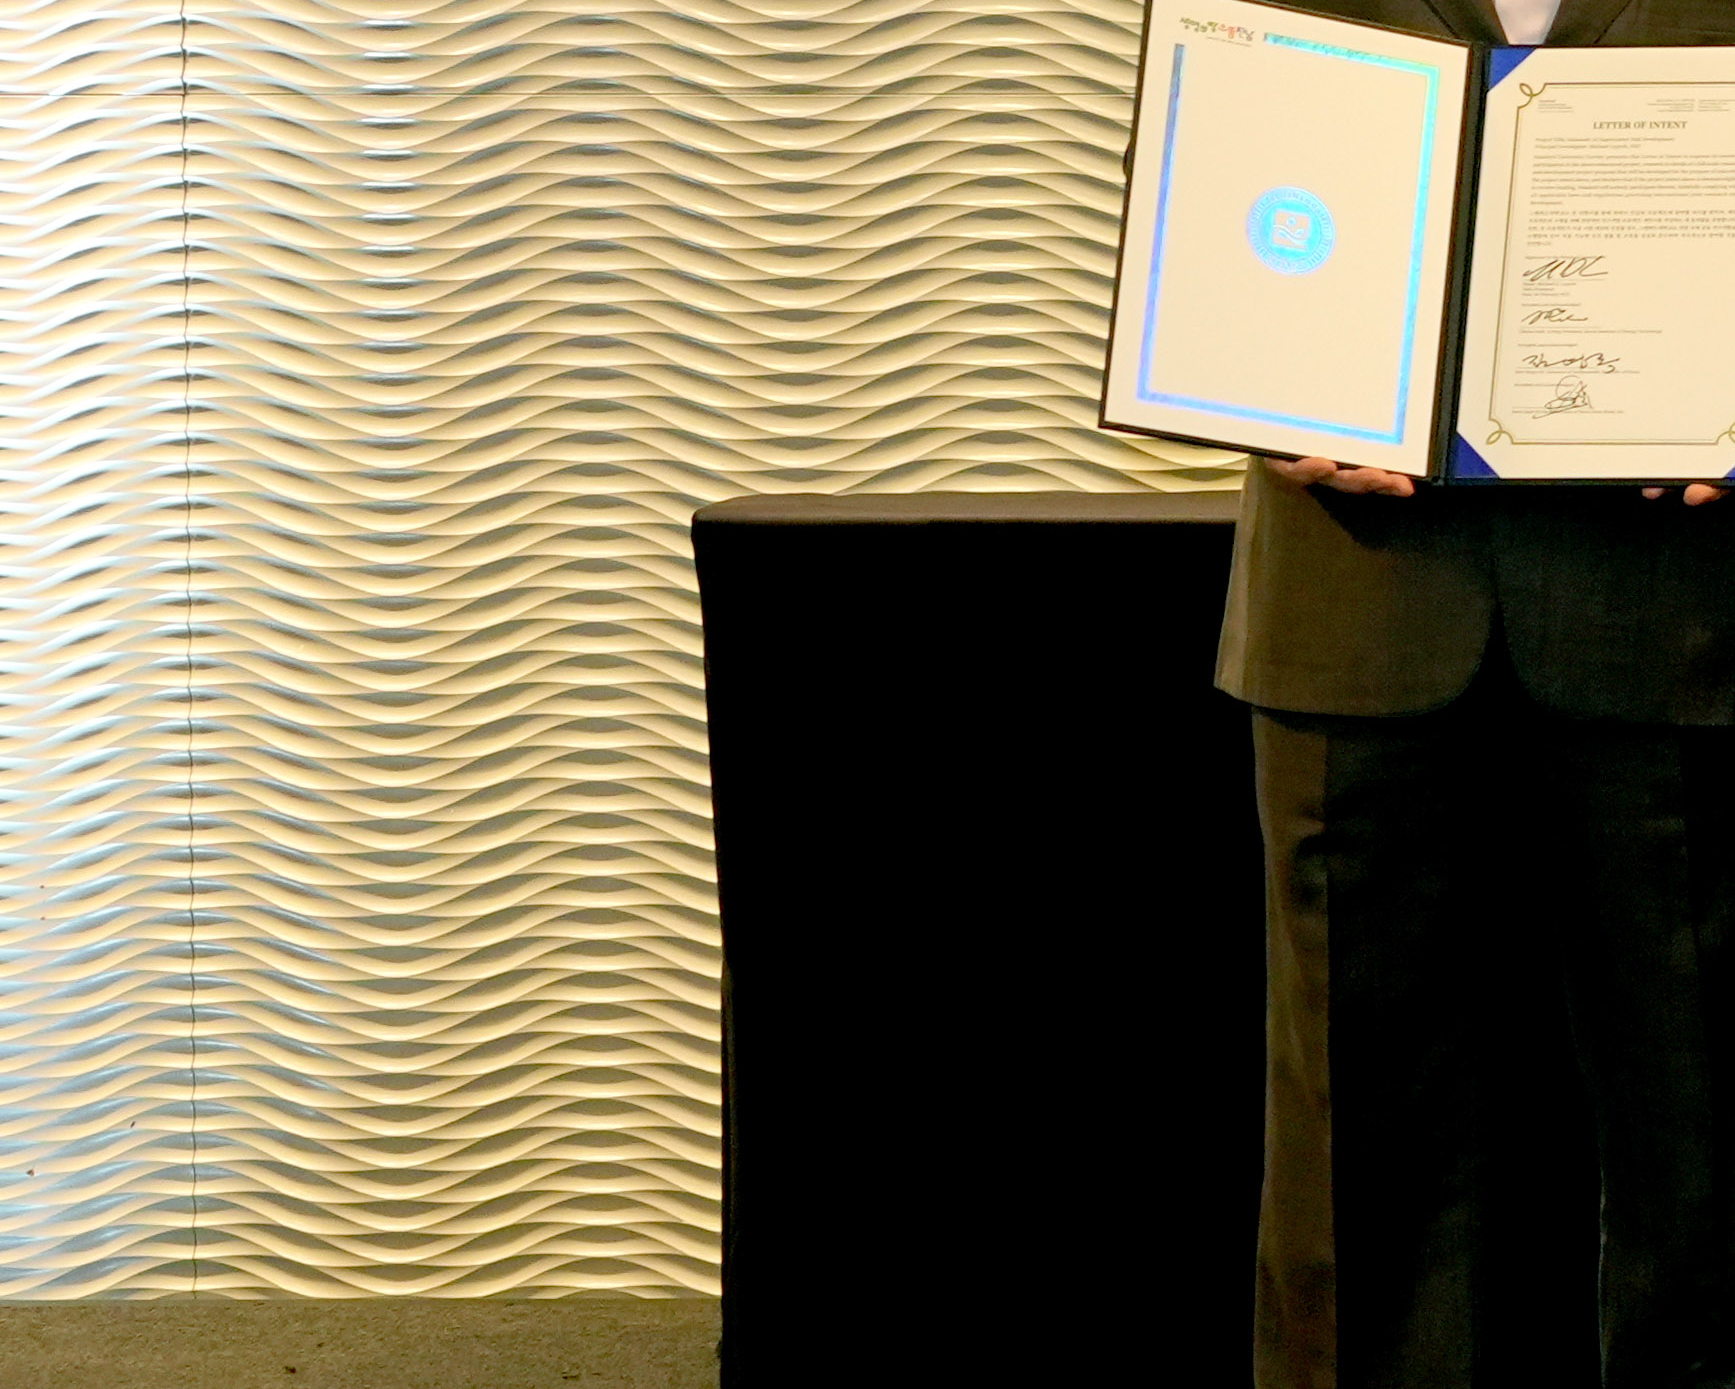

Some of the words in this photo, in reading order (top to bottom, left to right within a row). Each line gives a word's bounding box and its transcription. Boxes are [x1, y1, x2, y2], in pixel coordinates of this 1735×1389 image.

[1592, 120, 1631, 130] LETTER
[1633, 120, 1646, 130] OF
[1648, 120, 1688, 130] INTENT
